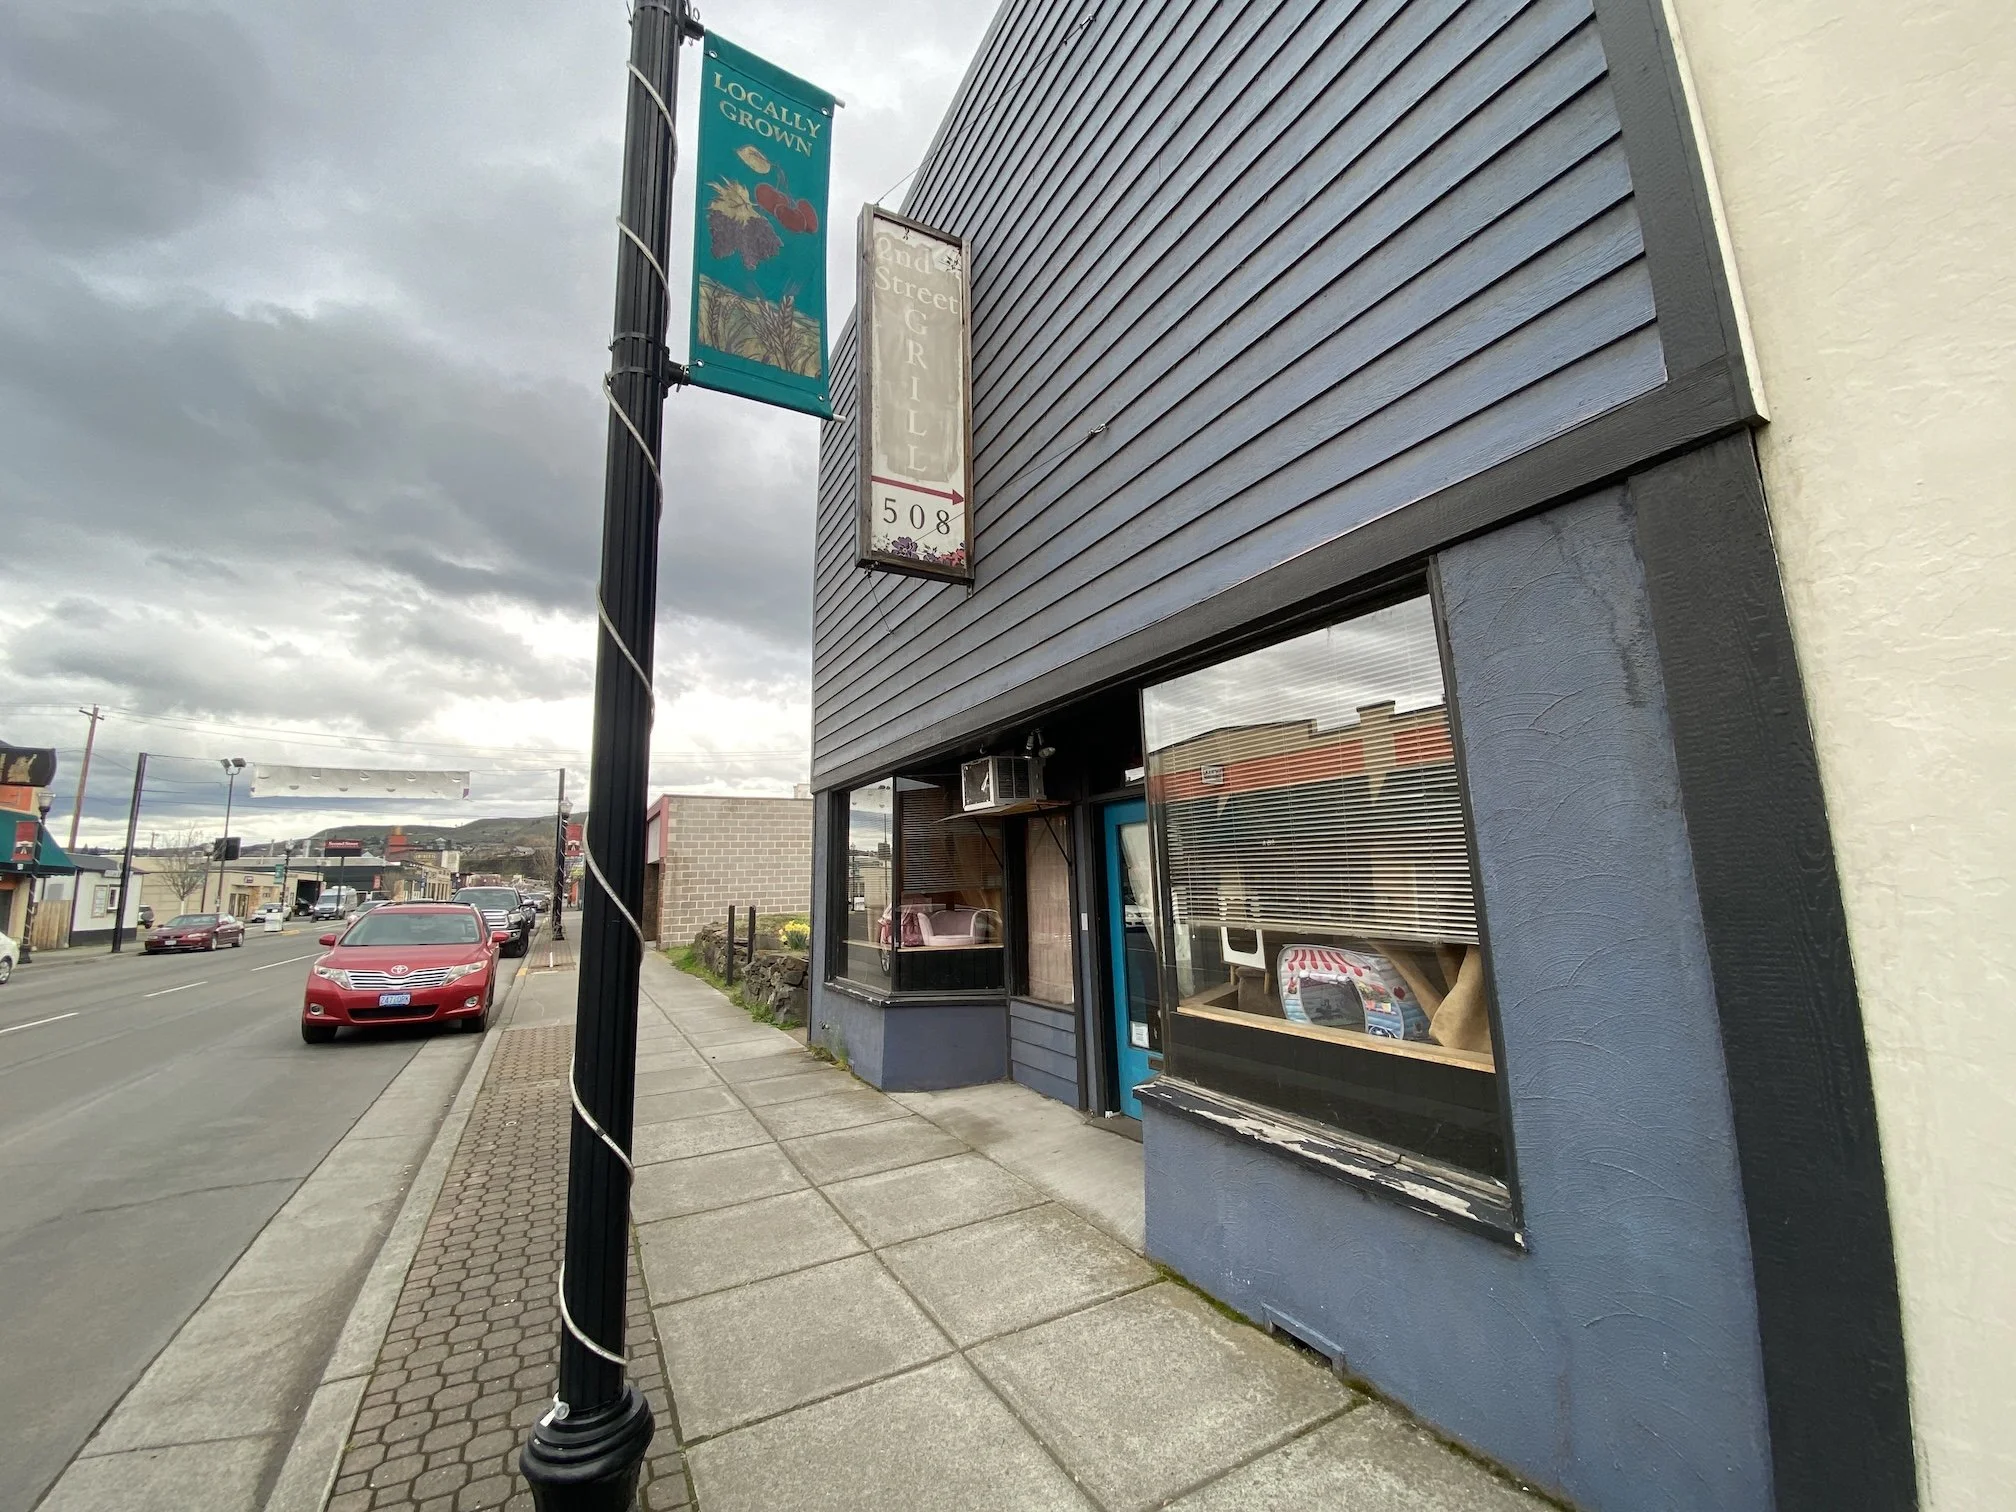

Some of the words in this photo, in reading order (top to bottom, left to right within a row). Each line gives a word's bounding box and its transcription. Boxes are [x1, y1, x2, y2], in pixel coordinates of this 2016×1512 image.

[713, 71, 821, 138] LOCALLY
[719, 100, 813, 157] GROWN
[874, 236, 934, 275] 2nd
[874, 266, 960, 315] Street
[904, 308, 929, 473] GRILL
[882, 497, 951, 535] 508
